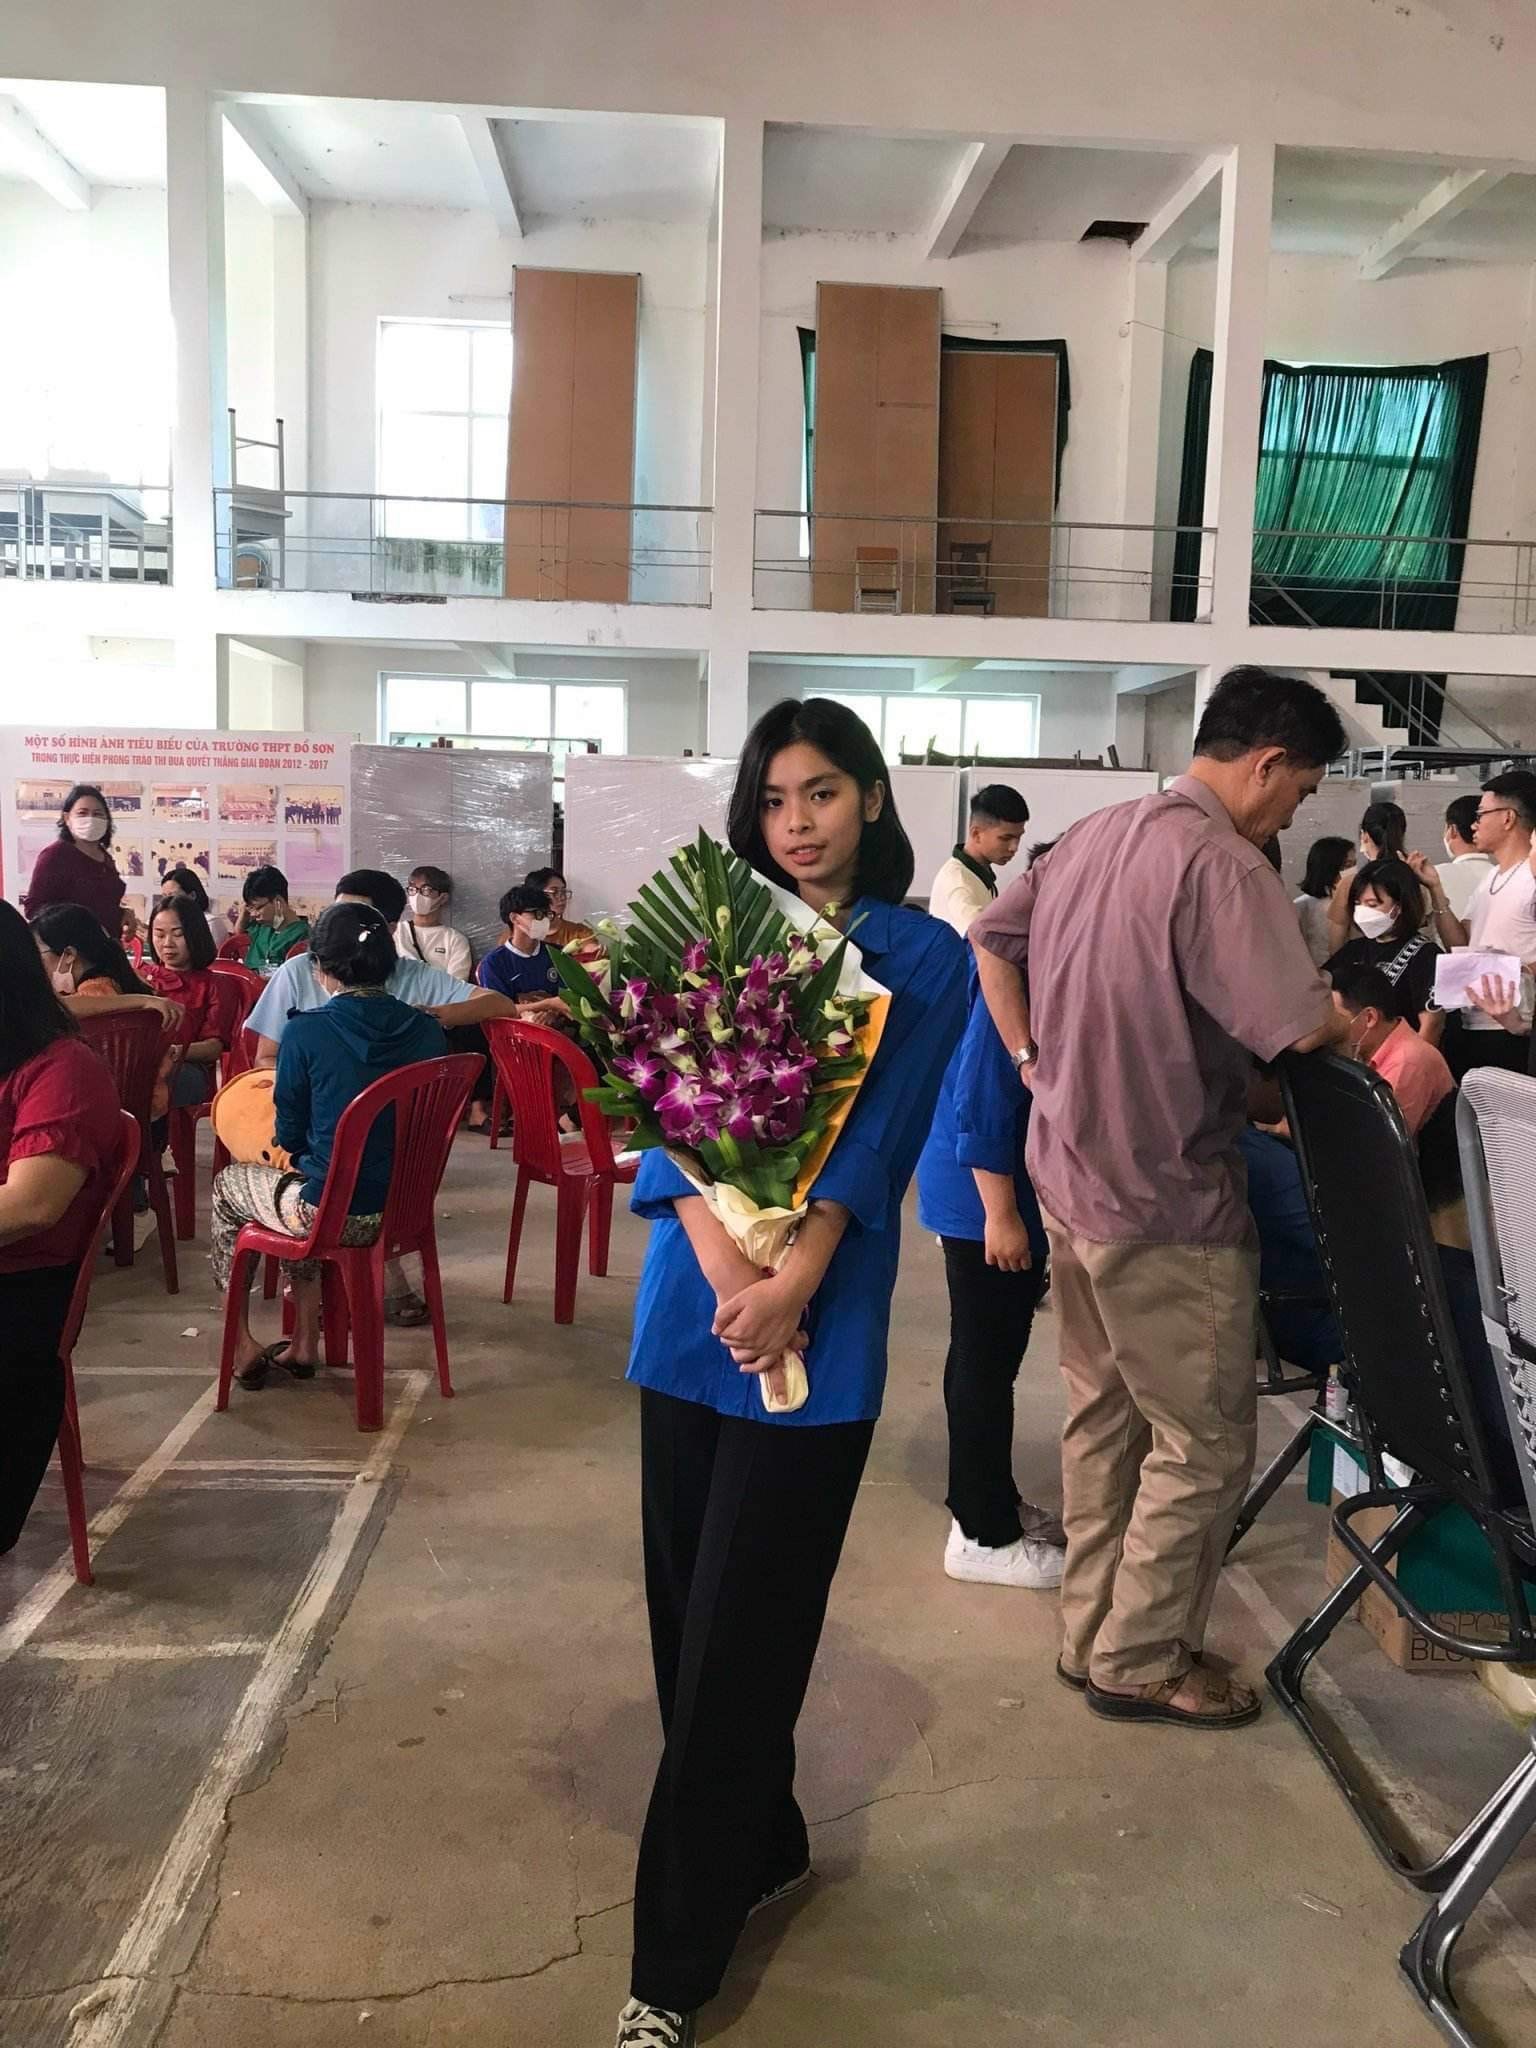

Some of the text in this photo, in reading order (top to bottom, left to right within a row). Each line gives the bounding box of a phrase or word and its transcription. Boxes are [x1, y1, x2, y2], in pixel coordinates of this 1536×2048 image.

[24, 734, 49, 749] MỘT
[52, 733, 66, 747] SỐ
[68, 736, 97, 748] HÌNH
[100, 734, 124, 748] ẢNH
[128, 736, 154, 748] TIÊU
[156, 735, 182, 750] BIỂU
[186, 738, 208, 750] CỦA
[212, 740, 259, 752] TRƯỜNG
[262, 742, 290, 752] THPT
[312, 744, 334, 754] SƠN
[32, 752, 58, 763] TRONG
[60, 753, 80, 765] THỰC
[82, 752, 101, 766] HIỆN
[103, 754, 130, 764] PHONG
[154, 755, 166, 766] THI
[168, 756, 184, 766] ĐUA
[240, 758, 256, 768] GIAI
[258, 758, 280, 770] ĐOẠN
[282, 759, 302, 769] 2012
[309, 760, 328, 770] 2017
